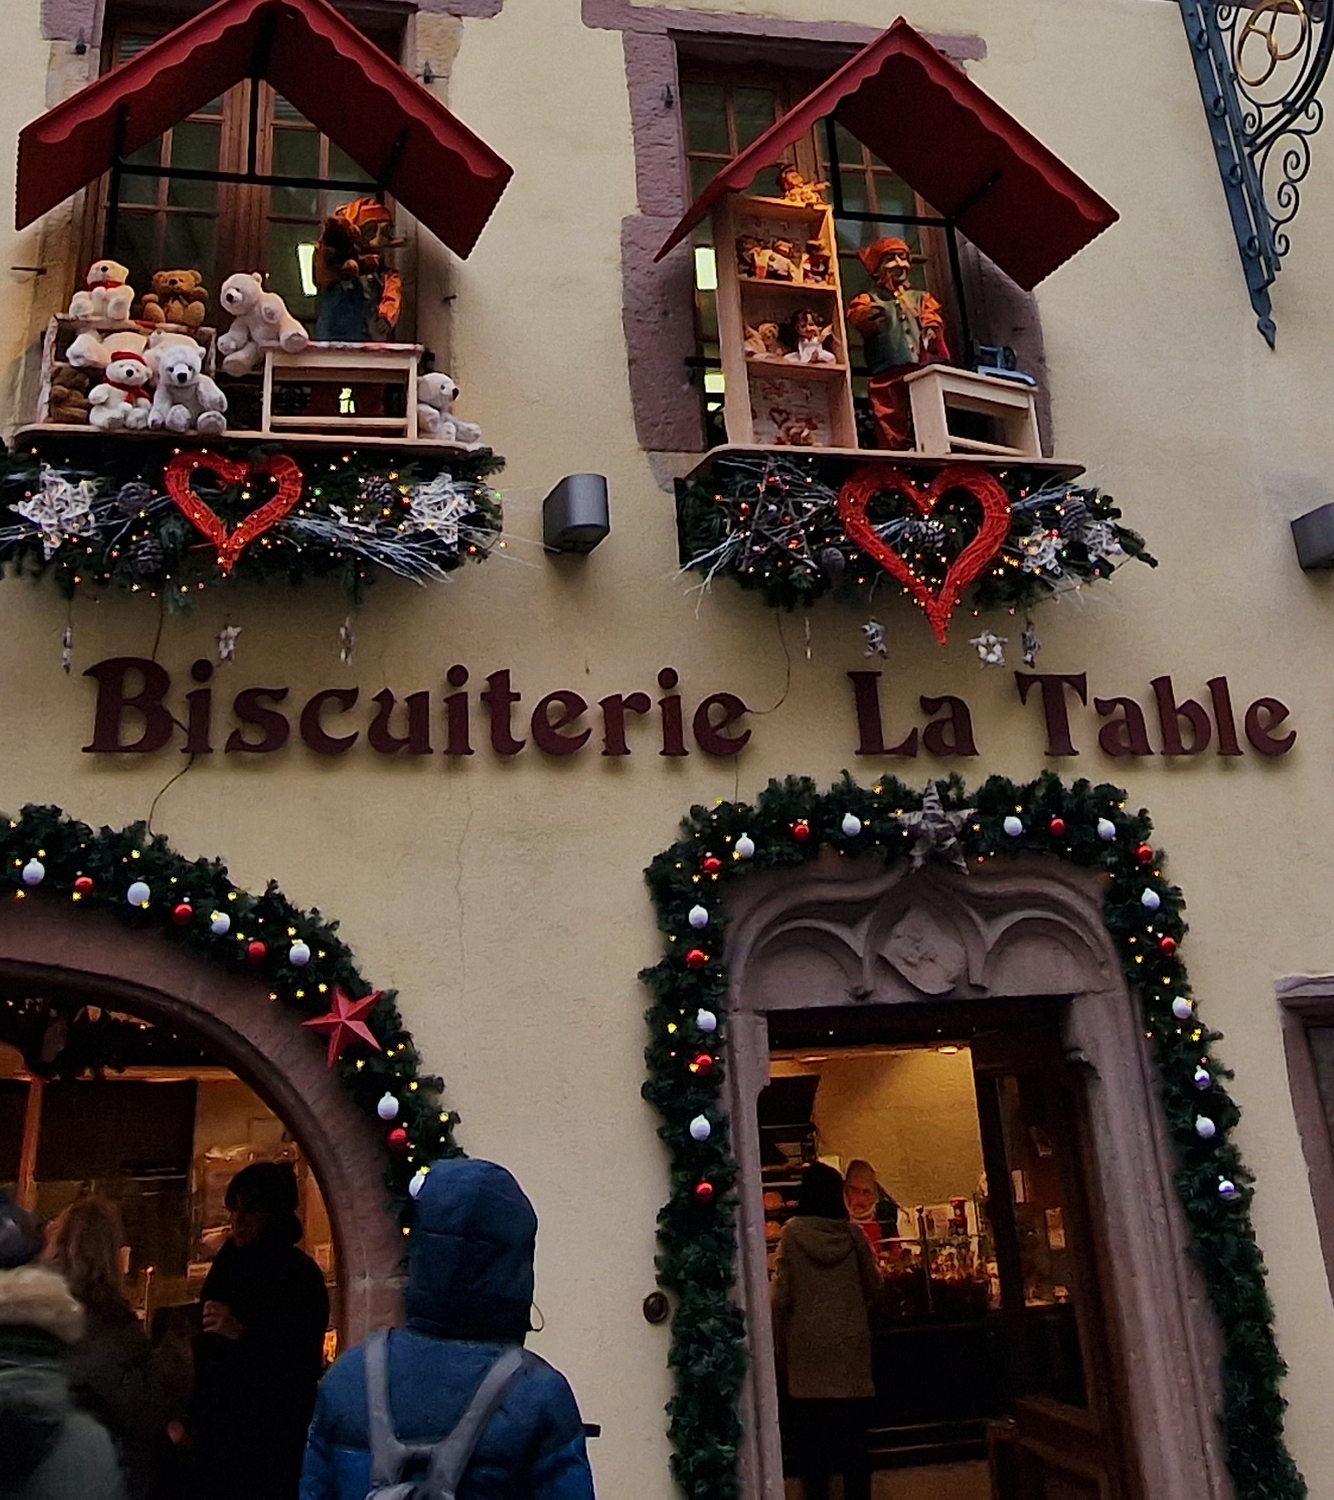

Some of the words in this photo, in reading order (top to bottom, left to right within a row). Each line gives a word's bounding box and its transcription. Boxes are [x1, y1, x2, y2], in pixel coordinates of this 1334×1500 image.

[82, 656, 752, 756] Biscuiterie
[847, 669, 979, 759] La
[1015, 670, 1296, 760] Table
